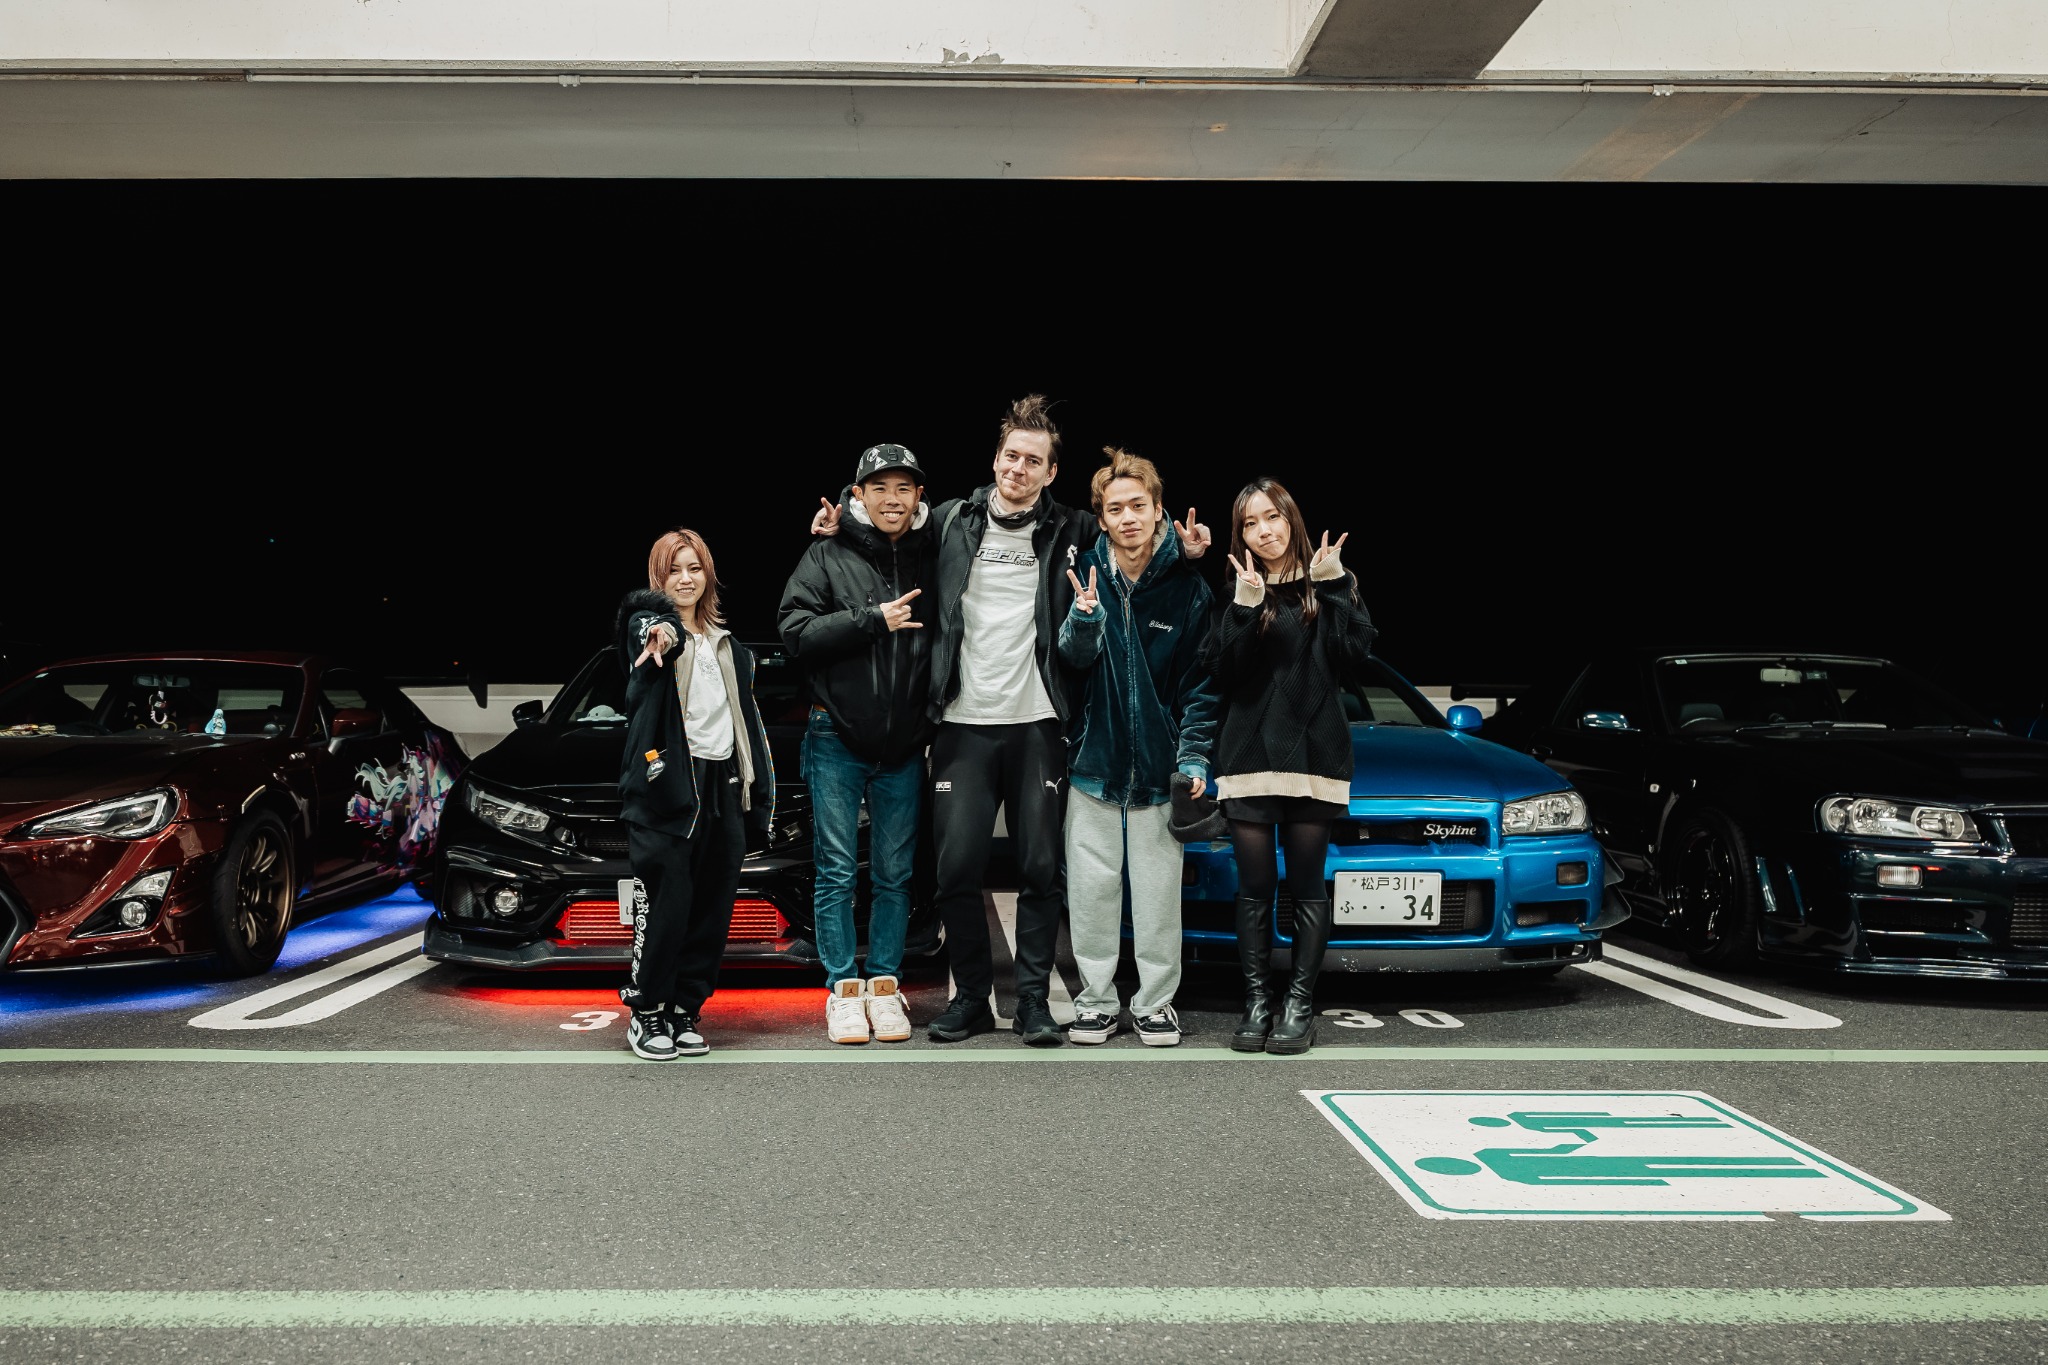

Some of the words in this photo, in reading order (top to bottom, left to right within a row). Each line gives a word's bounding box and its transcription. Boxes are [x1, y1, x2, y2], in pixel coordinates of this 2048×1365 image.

[1423, 823, 1477, 839] Skyline
[1403, 894, 1434, 921] 34
[559, 1010, 620, 1030] 3
[1321, 1009, 1465, 1028] 30
